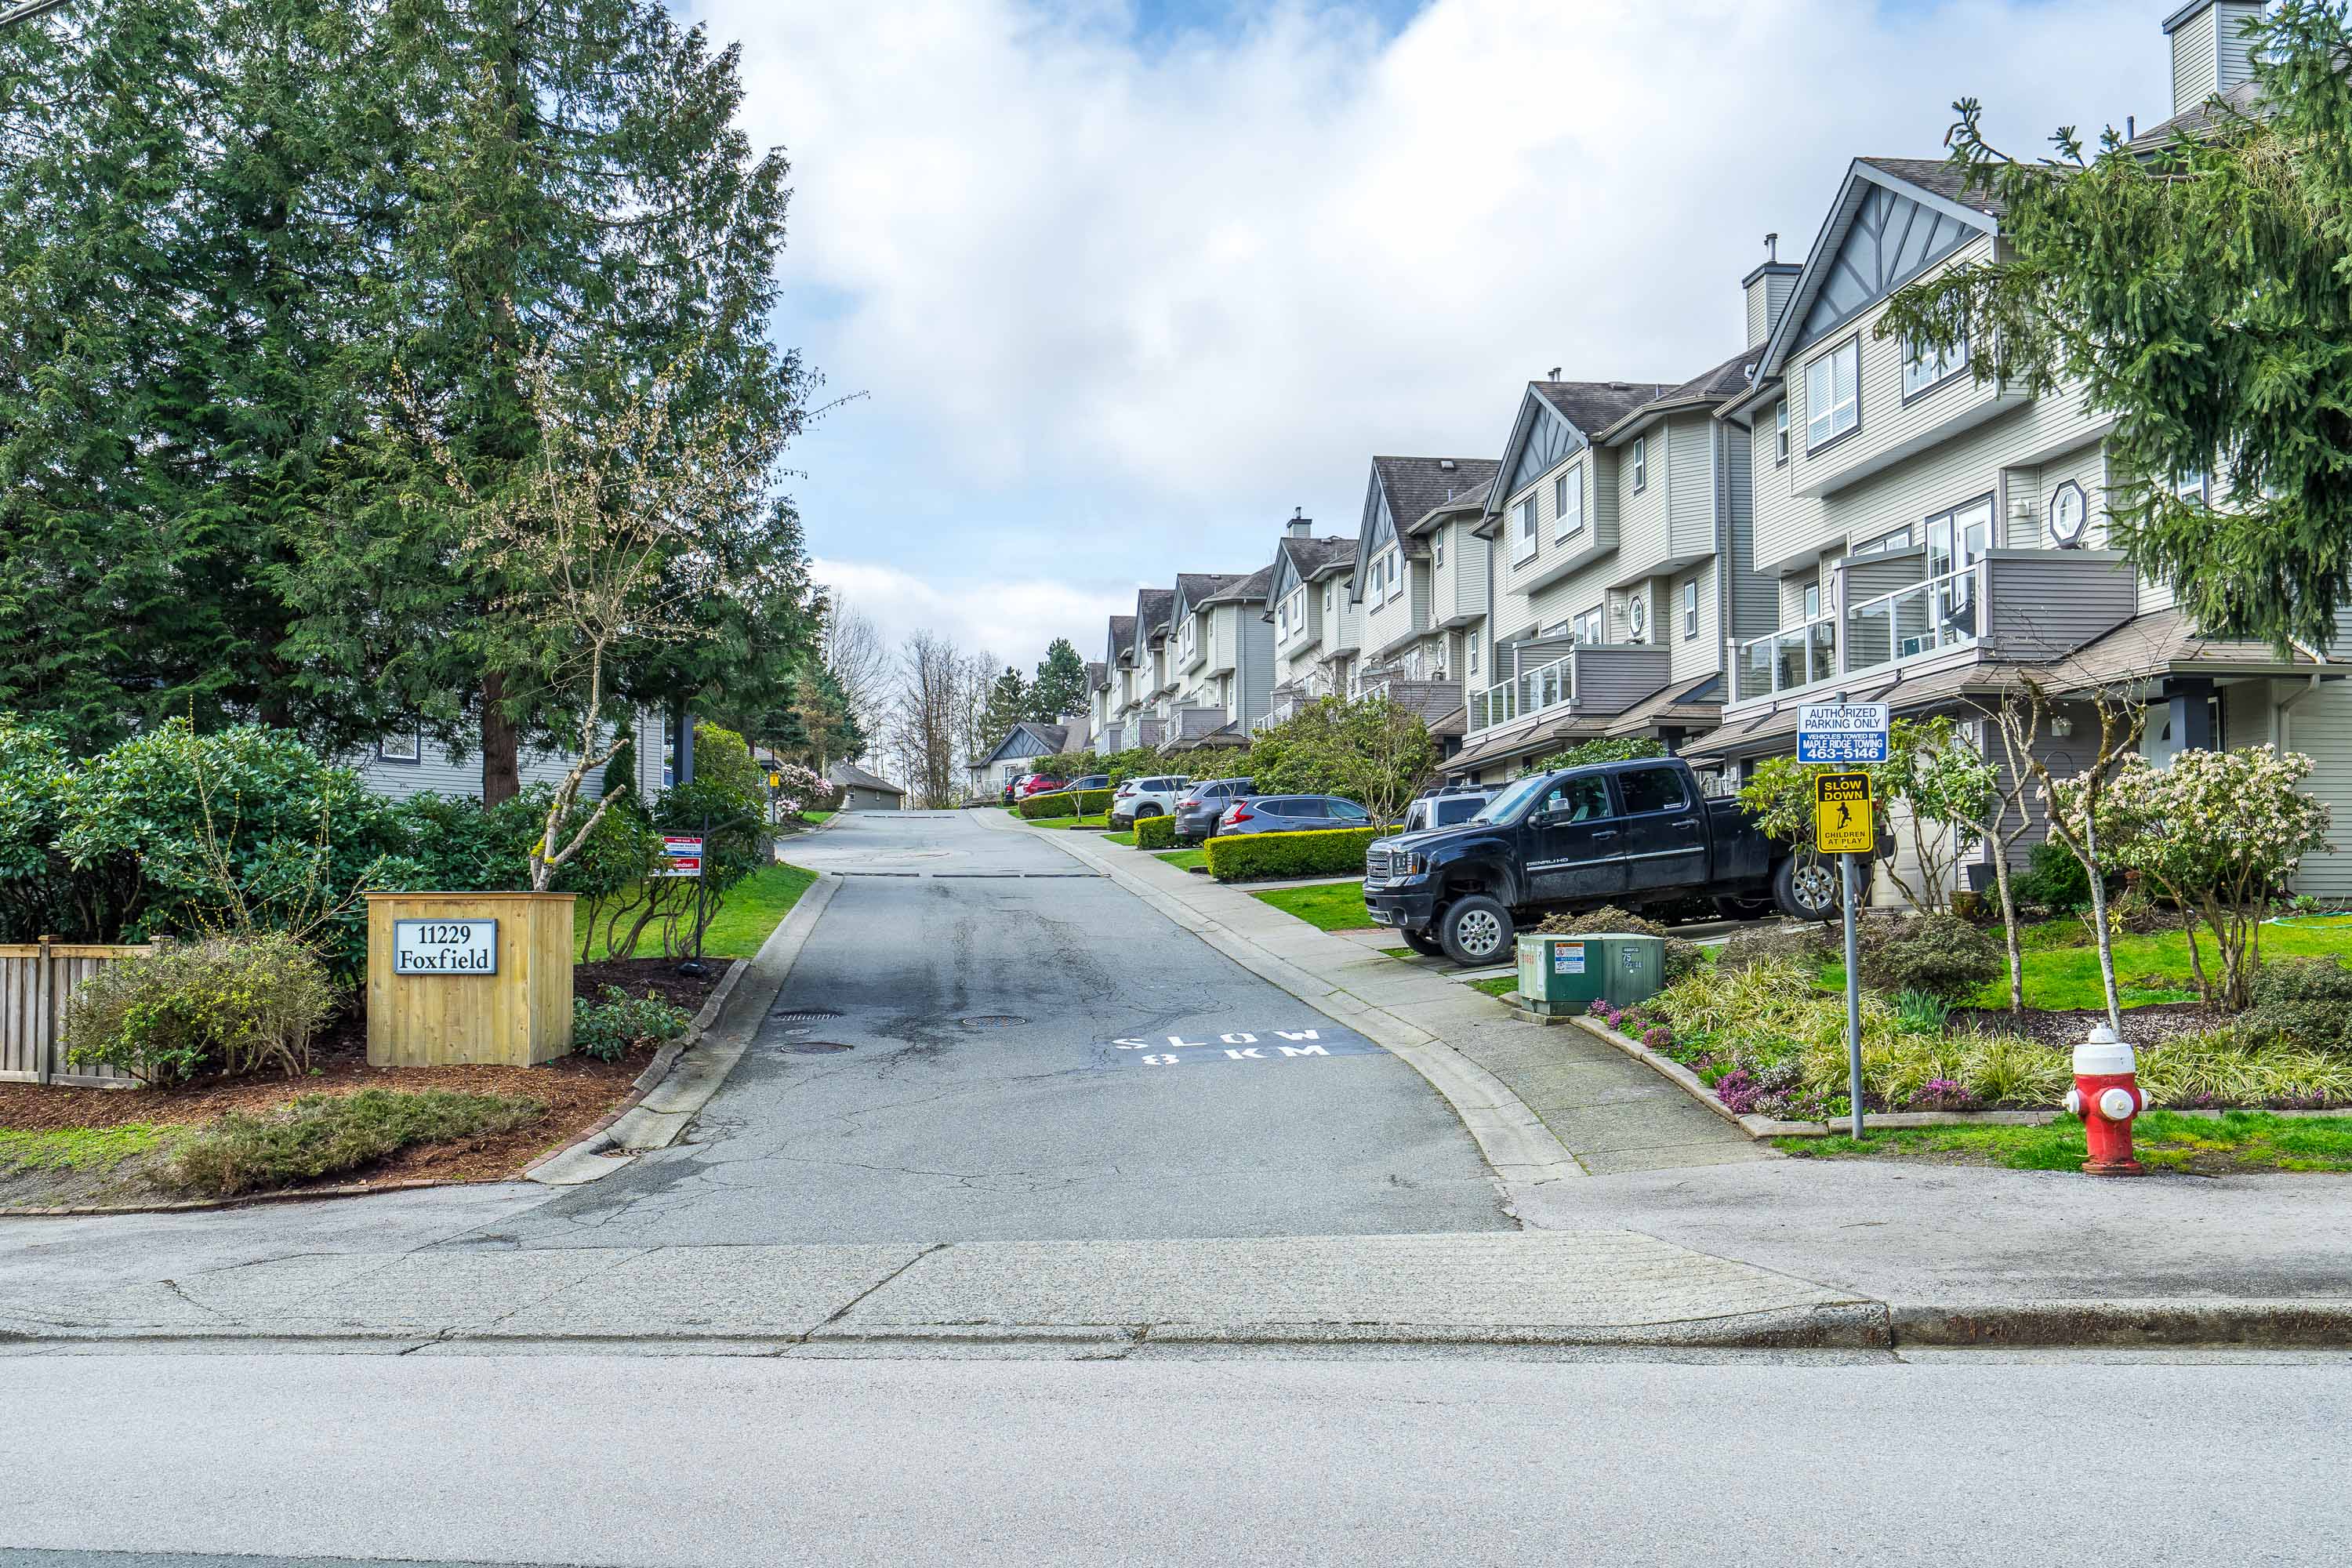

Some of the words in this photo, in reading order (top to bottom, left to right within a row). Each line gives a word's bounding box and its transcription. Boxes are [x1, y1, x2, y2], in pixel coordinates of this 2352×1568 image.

[1809, 708, 1877, 719] AUTHORIZED
[1805, 719, 1850, 729] PARKING
[1853, 718, 1882, 729] ONLY
[1803, 740, 1828, 749] MAPLE
[1829, 739, 1852, 749] RIDGE
[1853, 739, 1883, 748] TOWING
[1806, 749, 1879, 759] 463-5146
[1824, 781, 1862, 791] SLOW
[1824, 791, 1863, 801] DOWN
[1824, 830, 1866, 839] CHILDREN
[419, 925, 471, 944] 11229
[400, 948, 489, 969] Foxfield
[1112, 1029, 1320, 1050] SLOW
[1141, 1054, 1180, 1065] 8
[1224, 1045, 1331, 1059] KM
